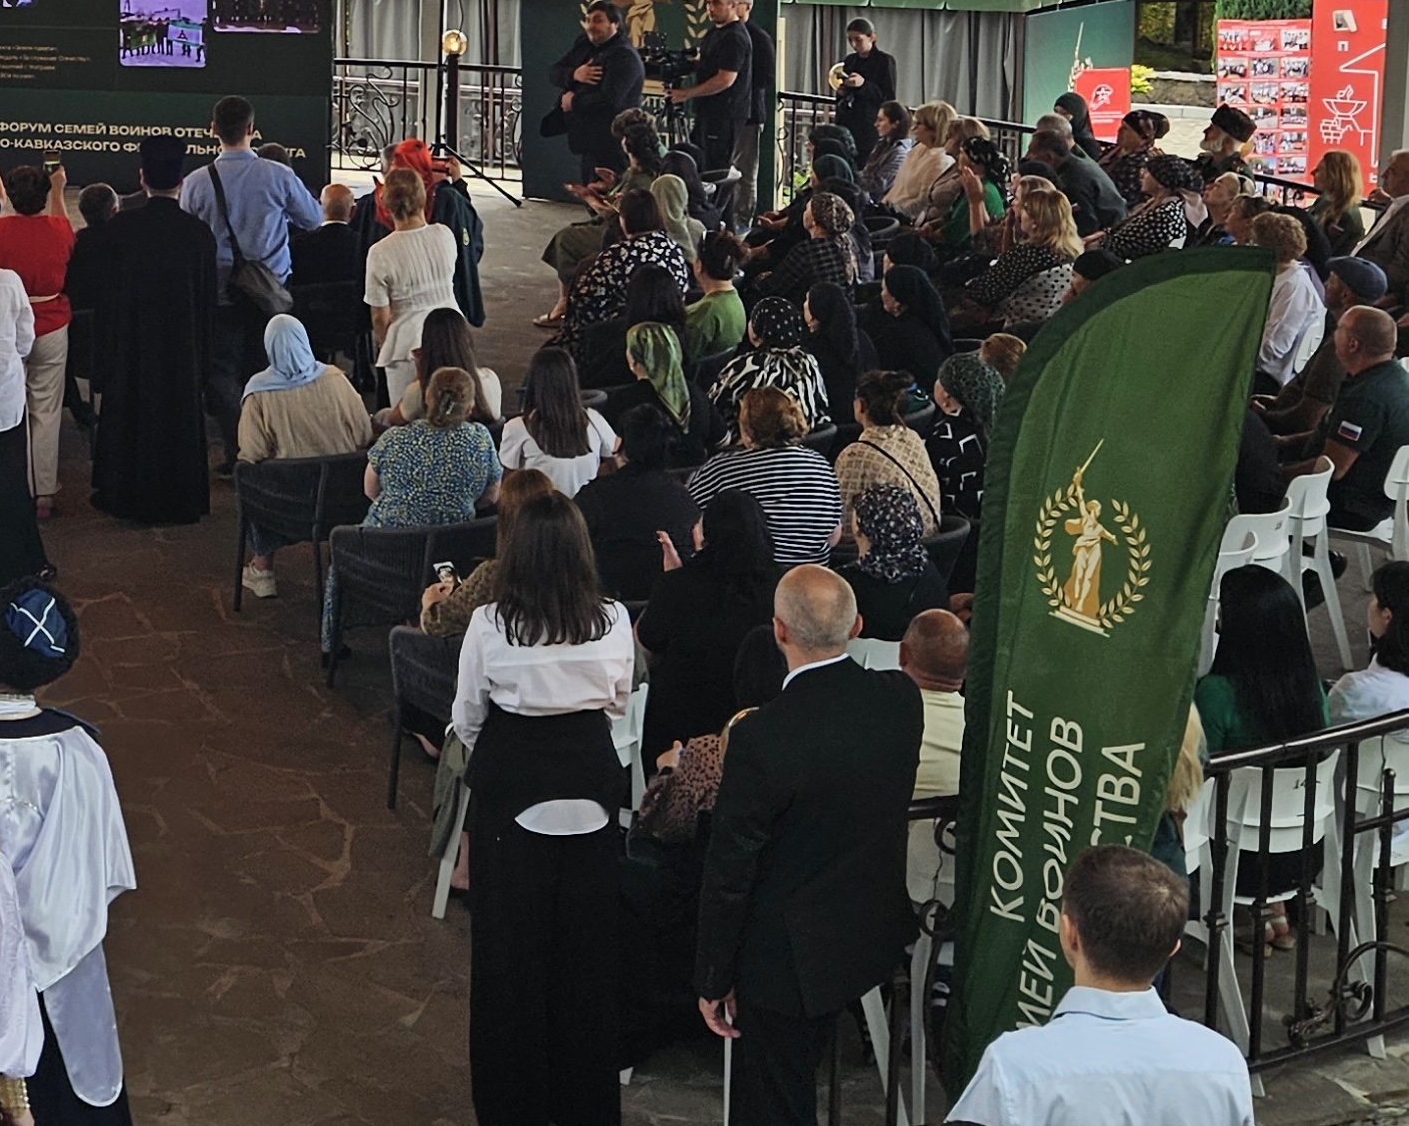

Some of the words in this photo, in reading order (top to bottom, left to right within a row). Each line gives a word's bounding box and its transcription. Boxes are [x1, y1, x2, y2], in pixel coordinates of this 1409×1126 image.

[54, 122, 106, 134] СЕМЕЙ
[174, 127, 262, 140] ОТЕЧА
[990, 690, 1034, 922] КОМИТЕТ
[1016, 938, 1056, 1031] МЕЙ
[1036, 716, 1083, 934] ВОИНОВ
